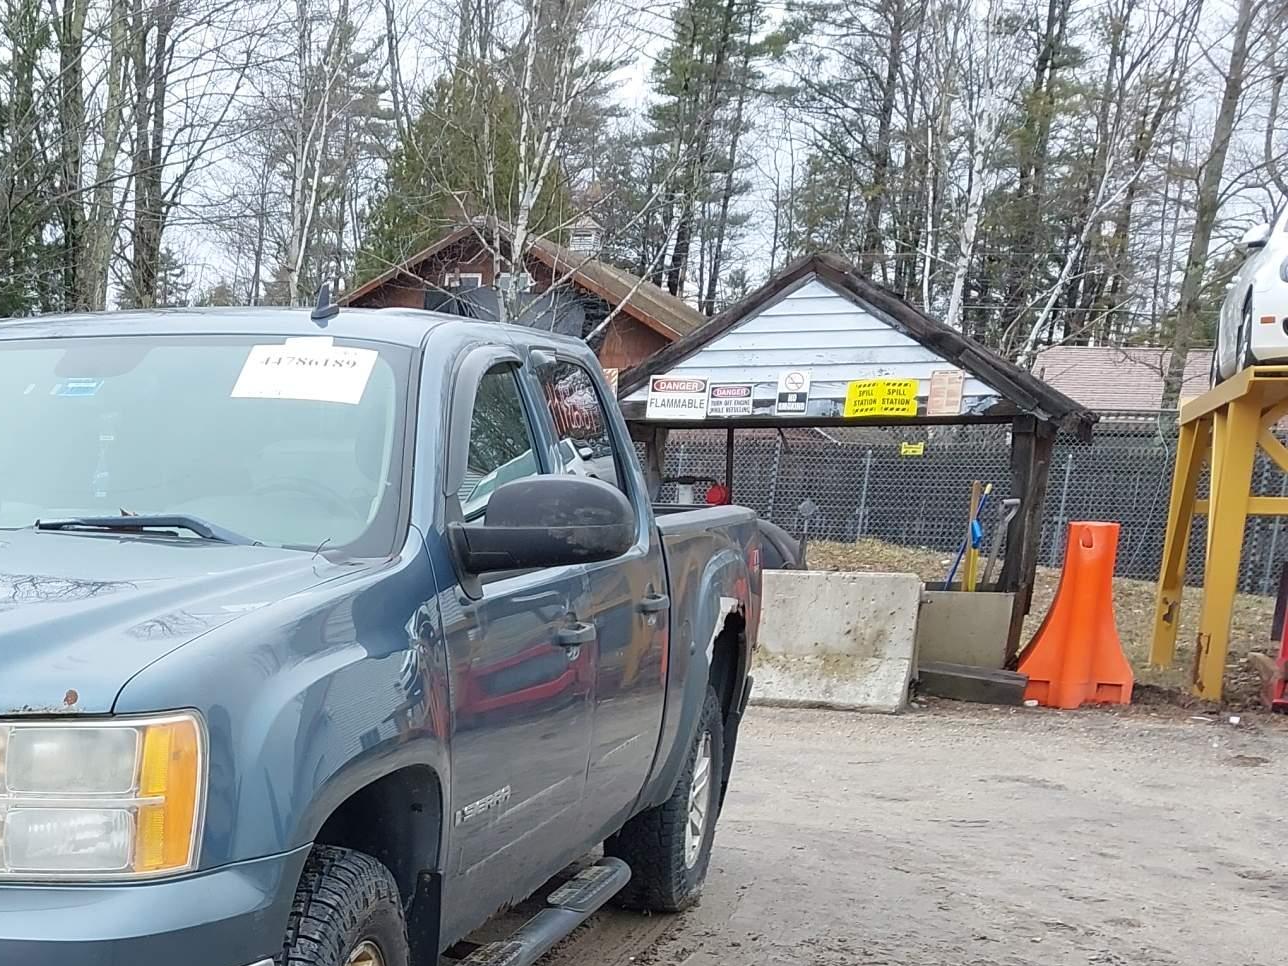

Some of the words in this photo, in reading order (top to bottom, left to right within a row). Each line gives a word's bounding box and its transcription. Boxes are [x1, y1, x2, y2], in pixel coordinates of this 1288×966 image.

[659, 380, 699, 391] DANGER
[716, 388, 746, 396] DANGER
[858, 389, 874, 397] SPILL
[887, 388, 907, 396] SPILL
[649, 398, 705, 409] FLAMMABLE
[853, 399, 877, 407] STATION
[881, 398, 910, 406] STATION
